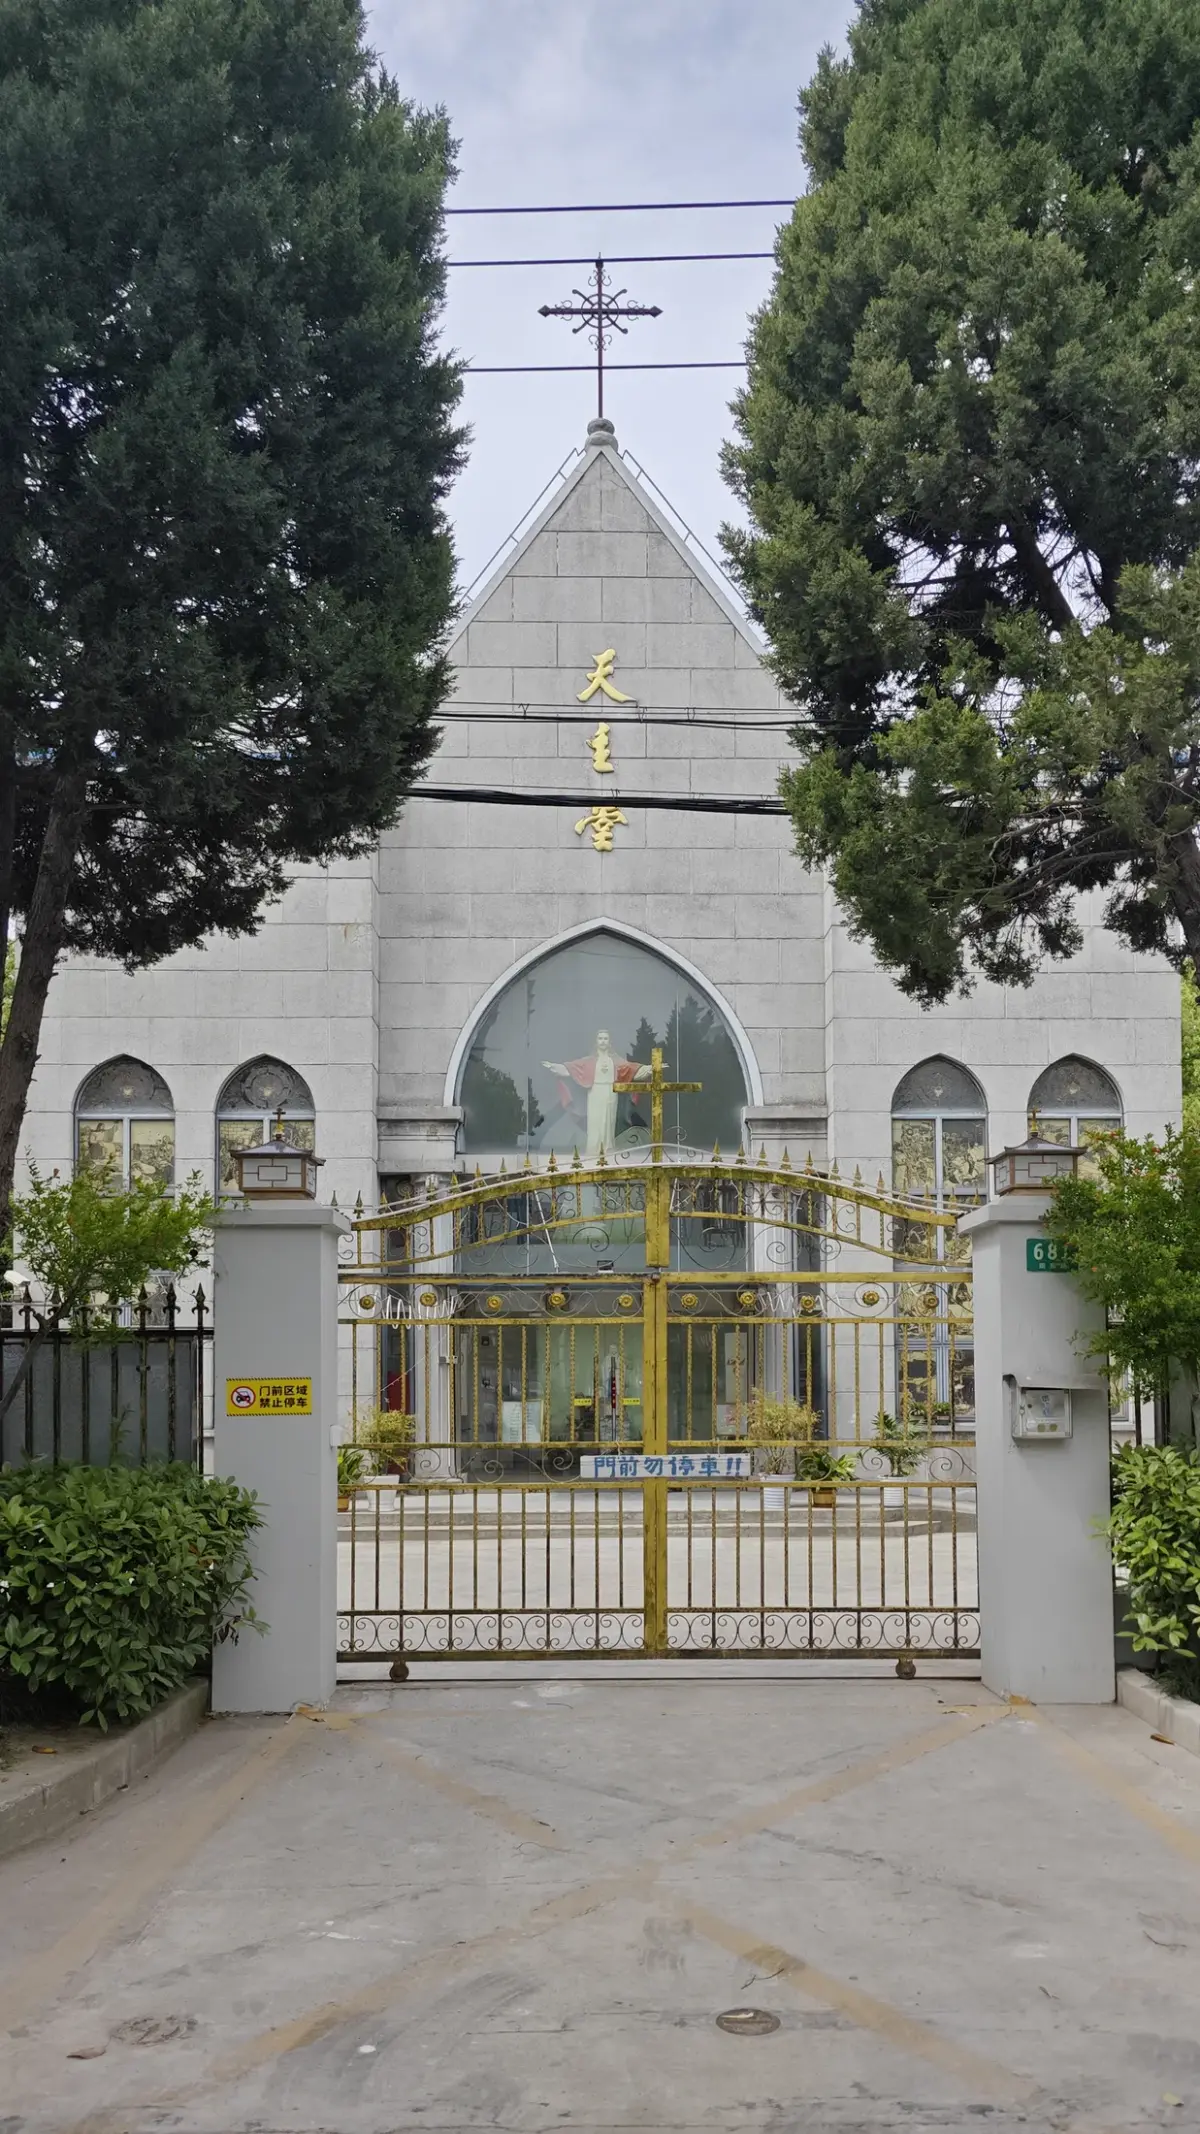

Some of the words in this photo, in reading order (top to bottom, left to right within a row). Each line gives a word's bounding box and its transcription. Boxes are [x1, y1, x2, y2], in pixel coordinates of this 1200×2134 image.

[575, 648, 639, 851] 天主堂
[259, 1385, 308, 1396] 门前区域
[259, 1397, 308, 1408] 禁止停车
